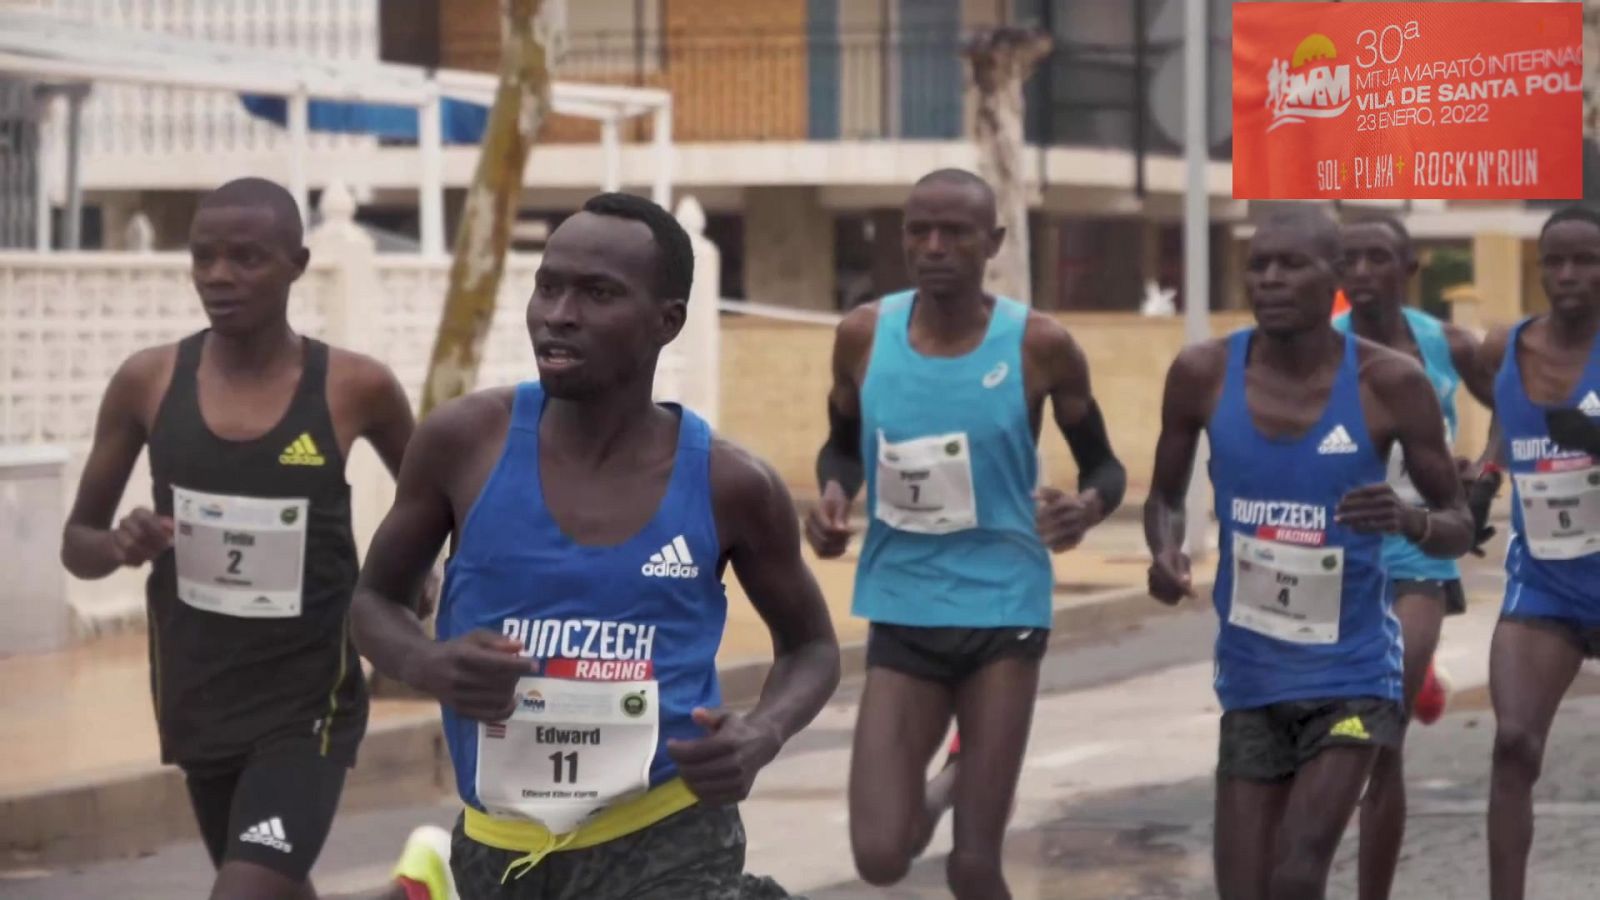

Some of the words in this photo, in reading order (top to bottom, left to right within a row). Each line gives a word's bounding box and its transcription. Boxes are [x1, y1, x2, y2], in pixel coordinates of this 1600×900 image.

[908, 485, 920, 503] 7
[1232, 498, 1326, 530] RUNCZECH
[226, 549, 242, 574] 2
[641, 561, 699, 579] adidas
[1278, 588, 1290, 607] 4
[502, 618, 656, 661] RUNCZECH
[575, 660, 648, 681] RACING
[535, 725, 601, 746] Edward
[548, 751, 579, 784] 11
